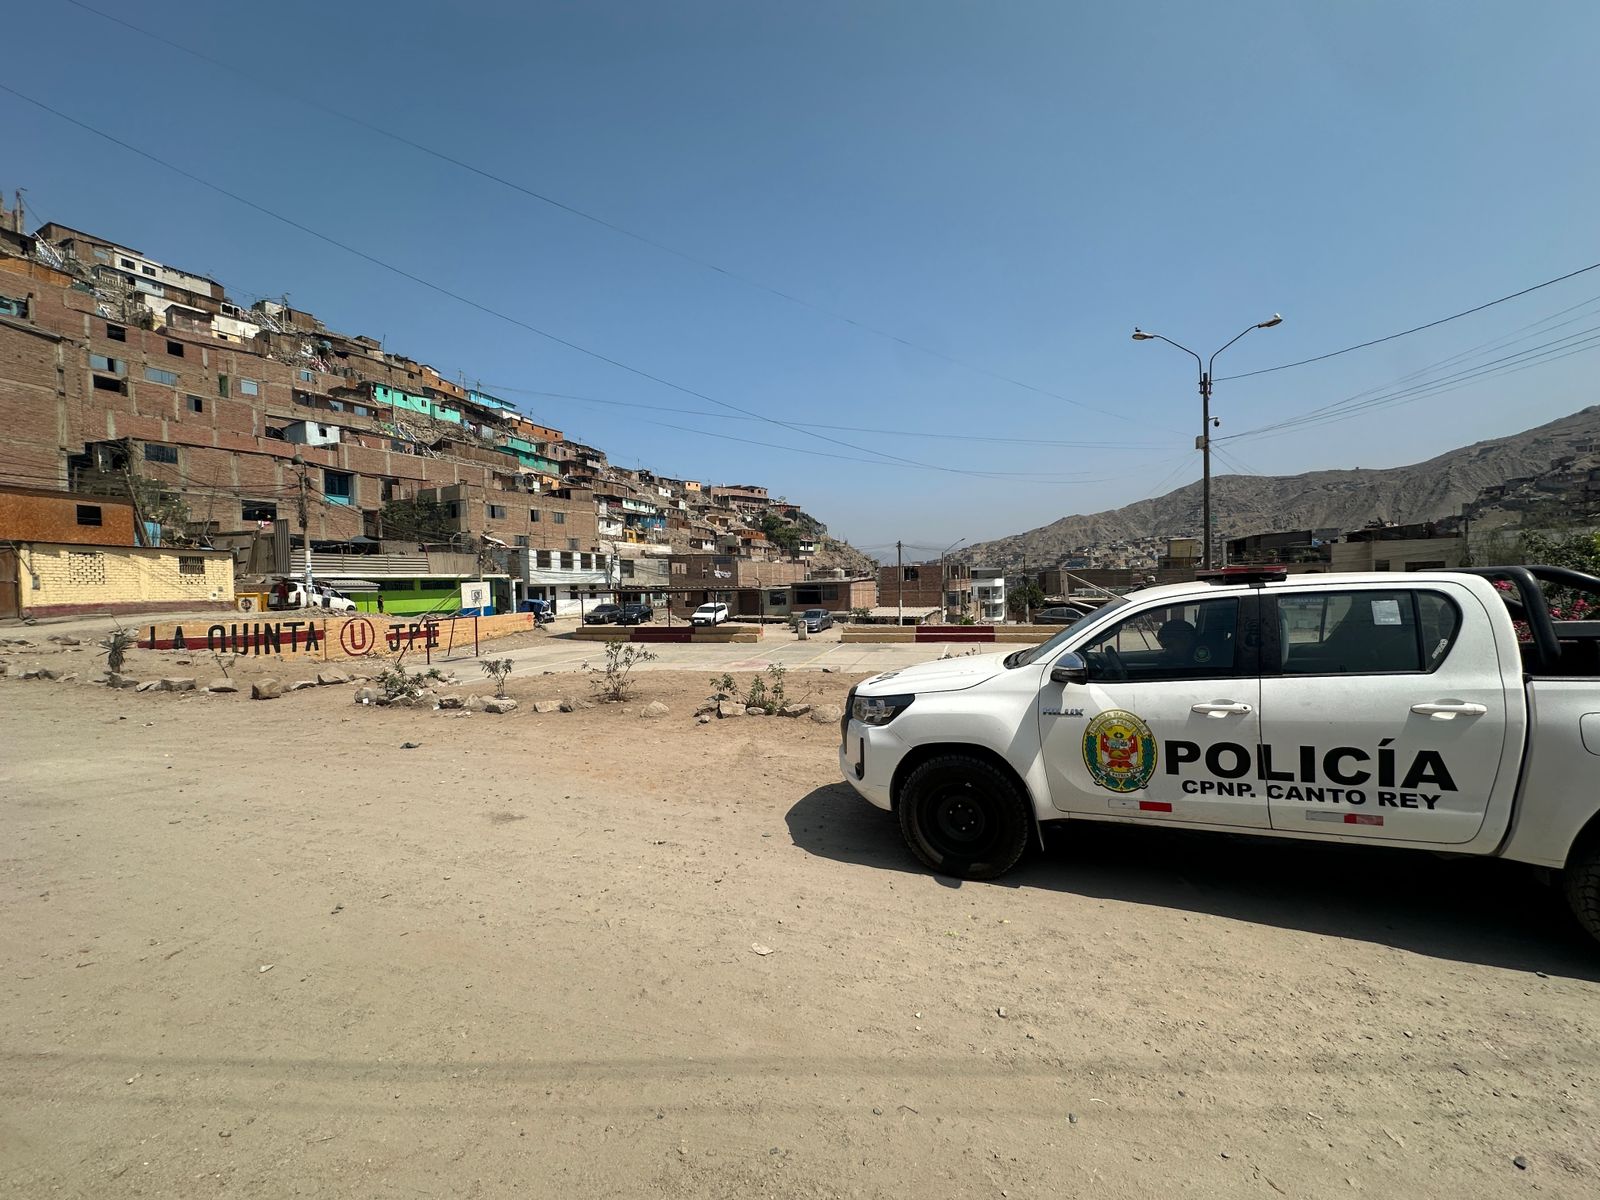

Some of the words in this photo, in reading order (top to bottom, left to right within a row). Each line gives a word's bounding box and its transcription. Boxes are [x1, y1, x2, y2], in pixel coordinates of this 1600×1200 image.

[350, 621, 366, 650] U
[1164, 738, 1458, 791] POLICÍA
[1181, 779, 1256, 798] CPNP.
[1266, 784, 1367, 805] CANTO
[1377, 790, 1442, 810] REY
